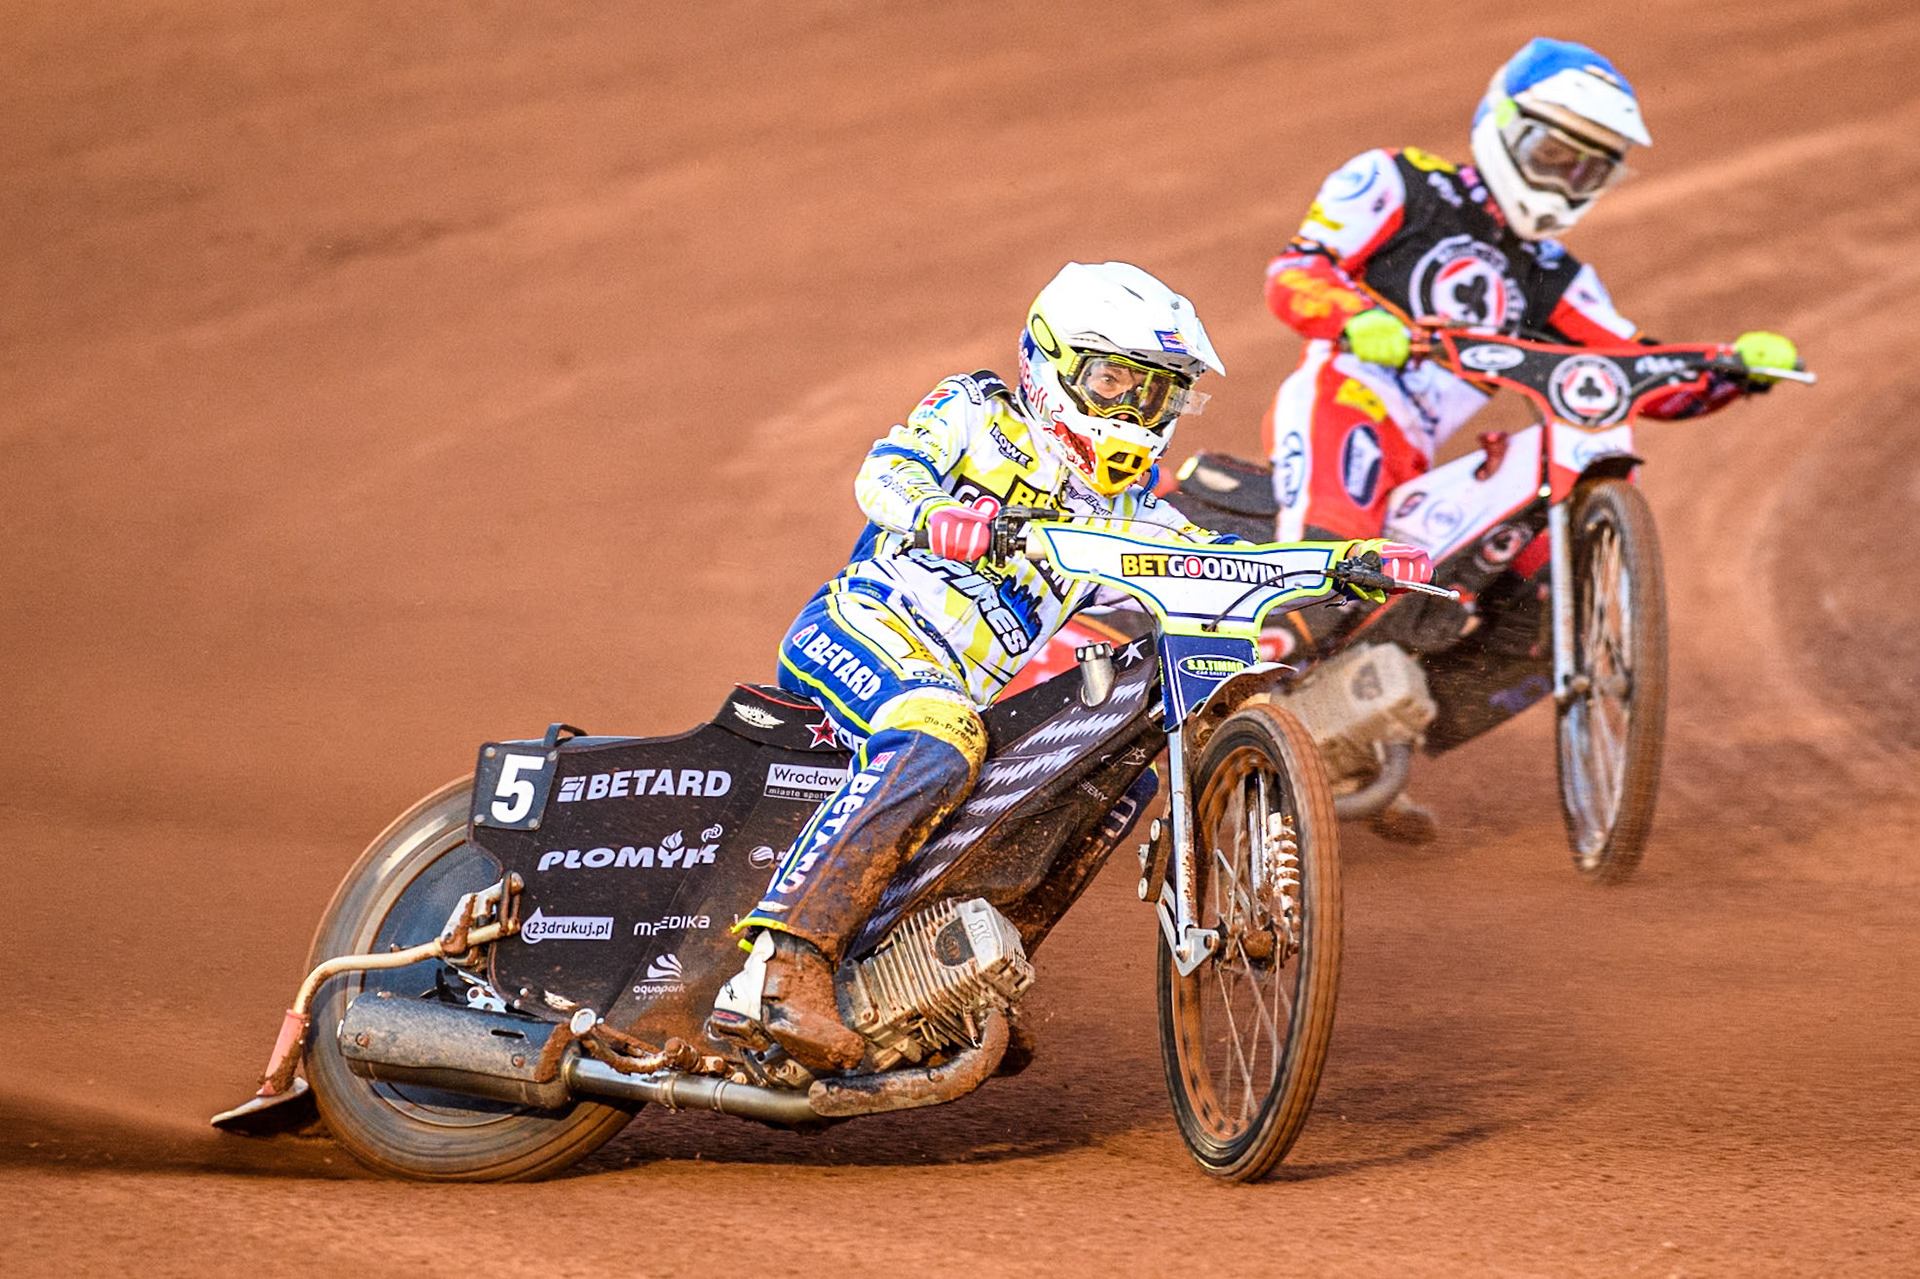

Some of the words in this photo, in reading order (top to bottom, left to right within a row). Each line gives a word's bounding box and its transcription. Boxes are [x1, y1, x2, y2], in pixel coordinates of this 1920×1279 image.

[991, 423, 1032, 467] ROWE
[802, 632, 881, 700] BETARD
[490, 753, 545, 823] 5
[586, 769, 731, 800] BETARD
[774, 767, 843, 787] Wrocław
[526, 919, 609, 936] 123drukuj.pl
[632, 983, 686, 995] aquapark
